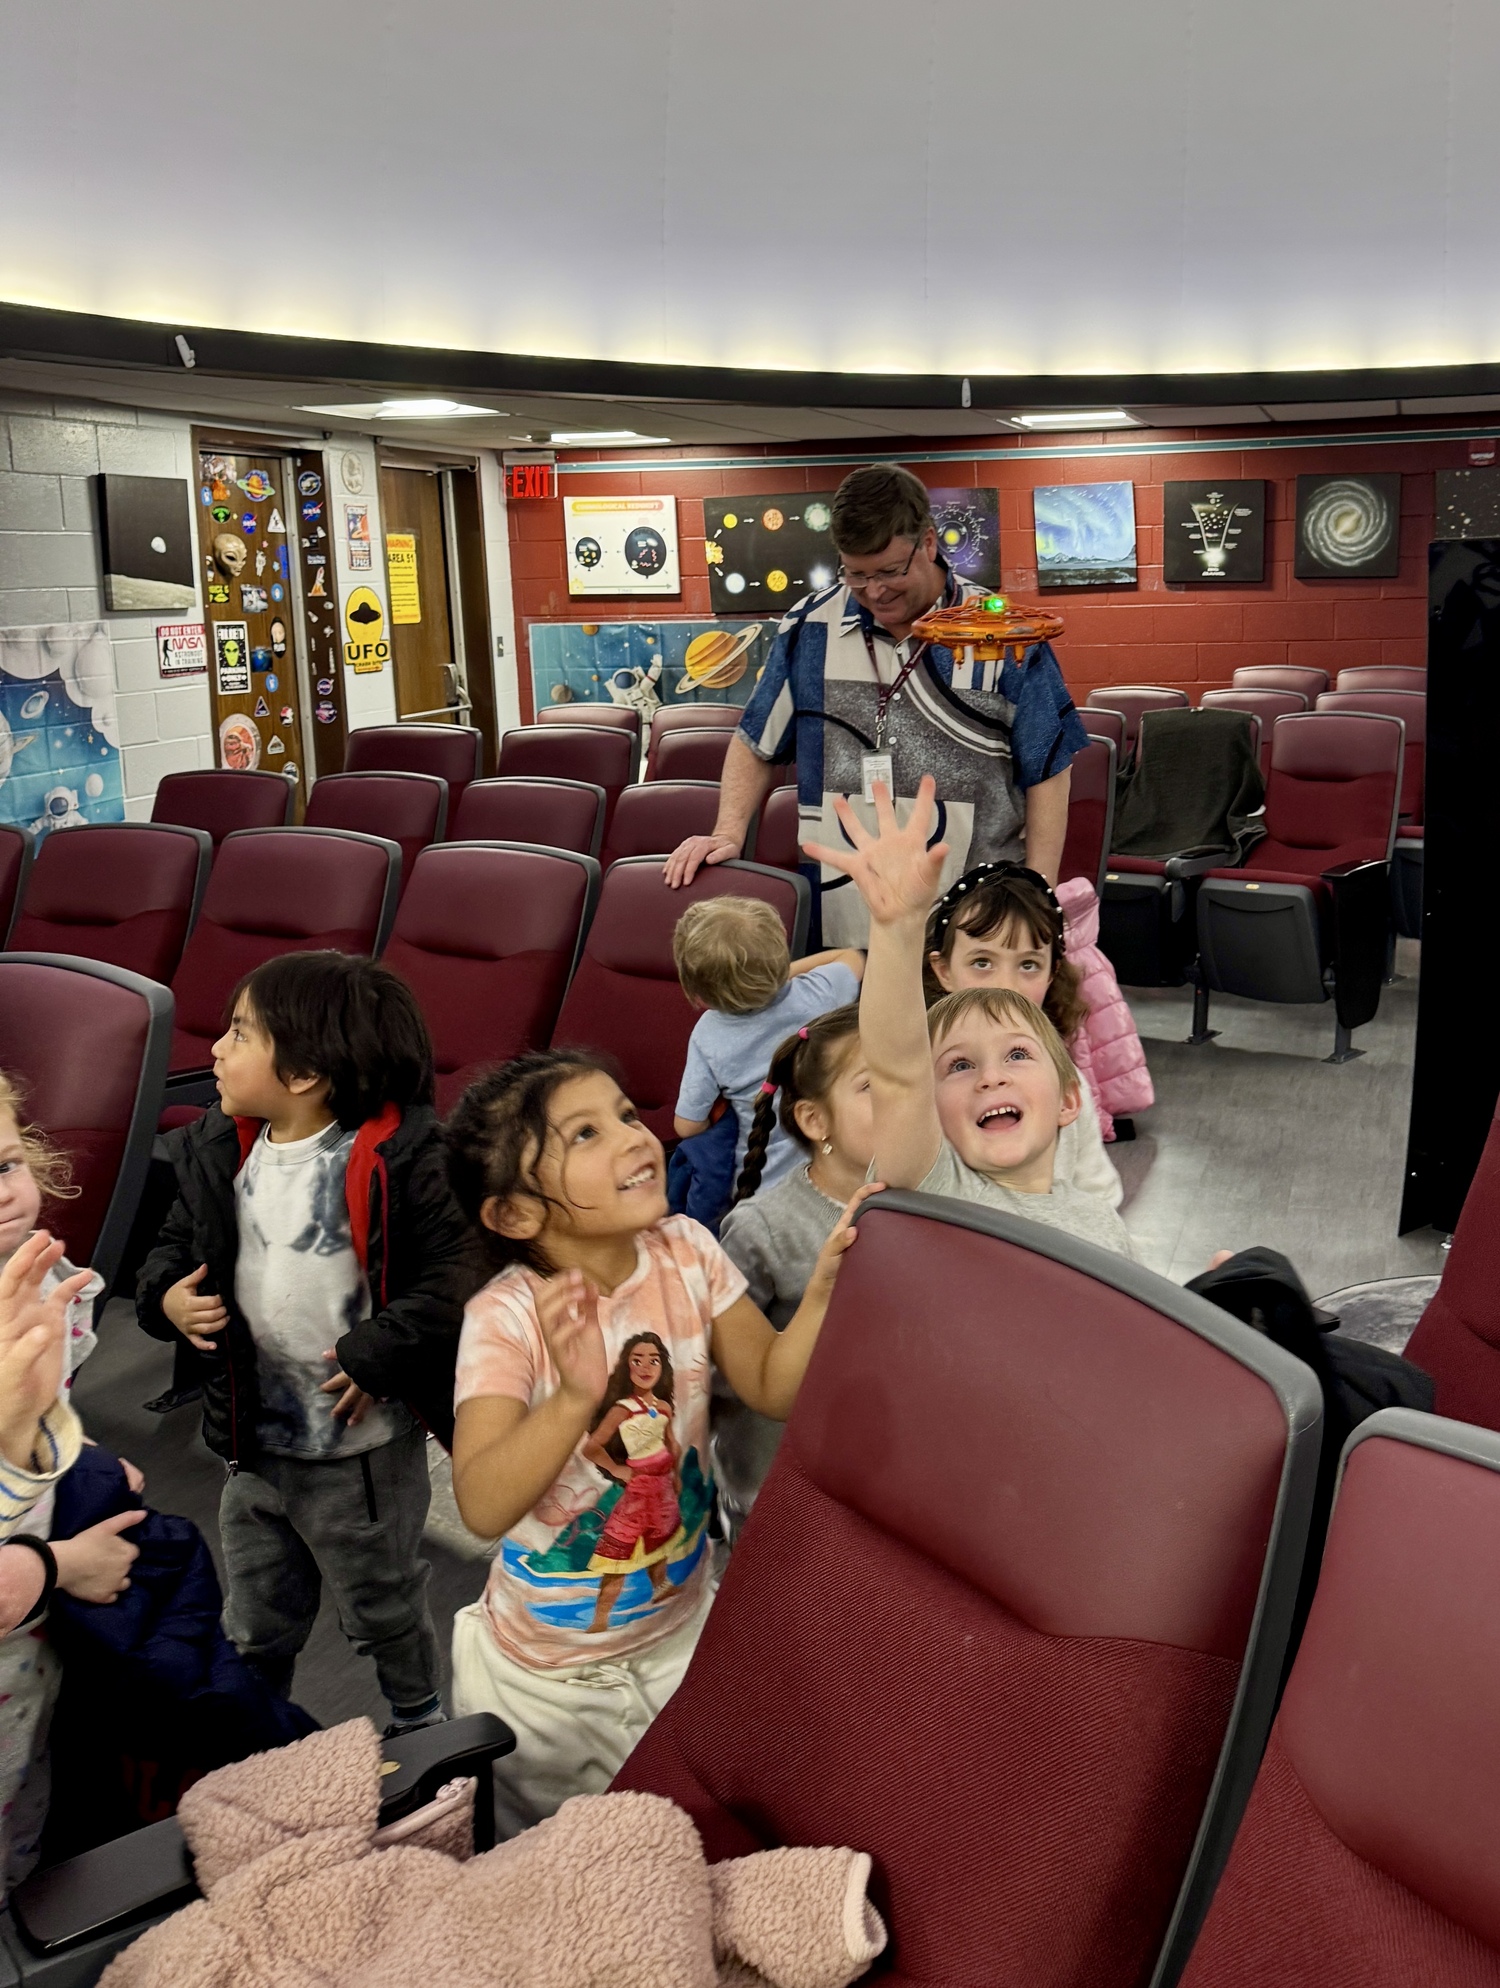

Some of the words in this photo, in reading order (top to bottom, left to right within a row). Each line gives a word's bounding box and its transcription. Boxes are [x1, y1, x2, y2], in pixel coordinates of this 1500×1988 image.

[512, 466, 551, 498] EXIT
[387, 539, 413, 549] WARNING
[388, 553, 405, 563] AREA
[406, 554, 414, 563] 51
[160, 627, 170, 637] DO
[170, 626, 182, 636] NOT
[182, 625, 203, 635] ENTER
[172, 637, 203, 650] NASA
[347, 642, 388, 661] UFO
